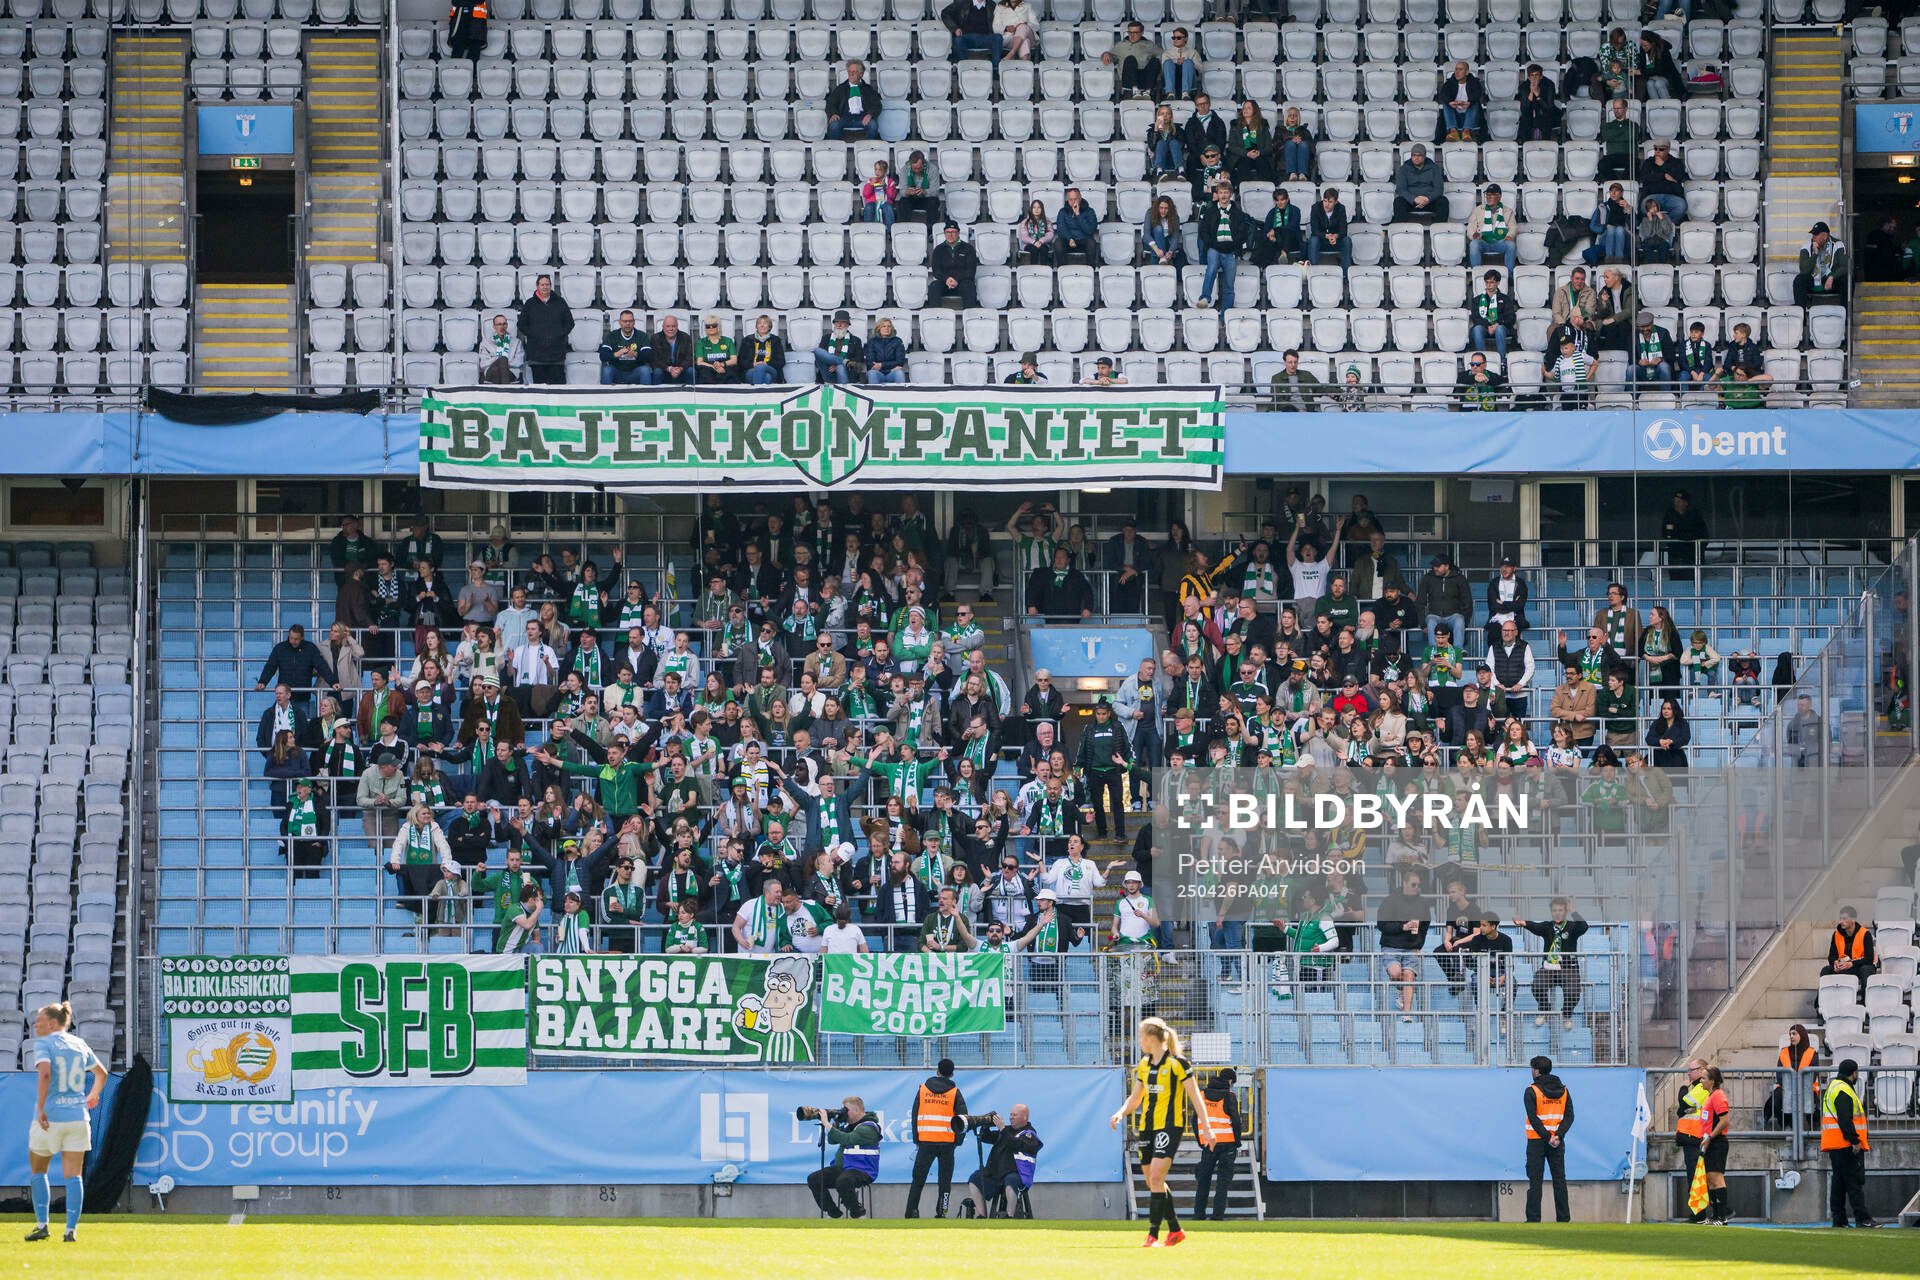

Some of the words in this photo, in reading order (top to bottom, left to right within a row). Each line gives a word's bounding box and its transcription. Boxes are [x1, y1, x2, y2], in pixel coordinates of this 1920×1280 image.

[445, 407, 1199, 462] BAJENKOMPANIET
[1691, 423, 1787, 456] bemt
[163, 974, 289, 997] BAJENKLASSIKERN
[536, 958, 732, 1005] SNYGGA
[826, 973, 1000, 1012] BAJARNA
[187, 1022, 218, 1042] Going
[221, 1020, 237, 1030] out
[241, 1020, 251, 1030] in
[253, 1020, 281, 1043] Style
[338, 962, 476, 1078] SFB
[535, 1004, 732, 1051] BAJARE
[870, 1010, 947, 1034] 2009
[55, 1055, 86, 1093] 16
[231, 1087, 245, 1097] on
[249, 1083, 277, 1096] Tour
[230, 1088, 378, 1136] reunify
[924, 1098, 949, 1106] SERVICE
[228, 1131, 349, 1168] group
[326, 1185, 342, 1200] 82
[599, 1185, 617, 1202] 83
[1499, 1182, 1514, 1196] 86
